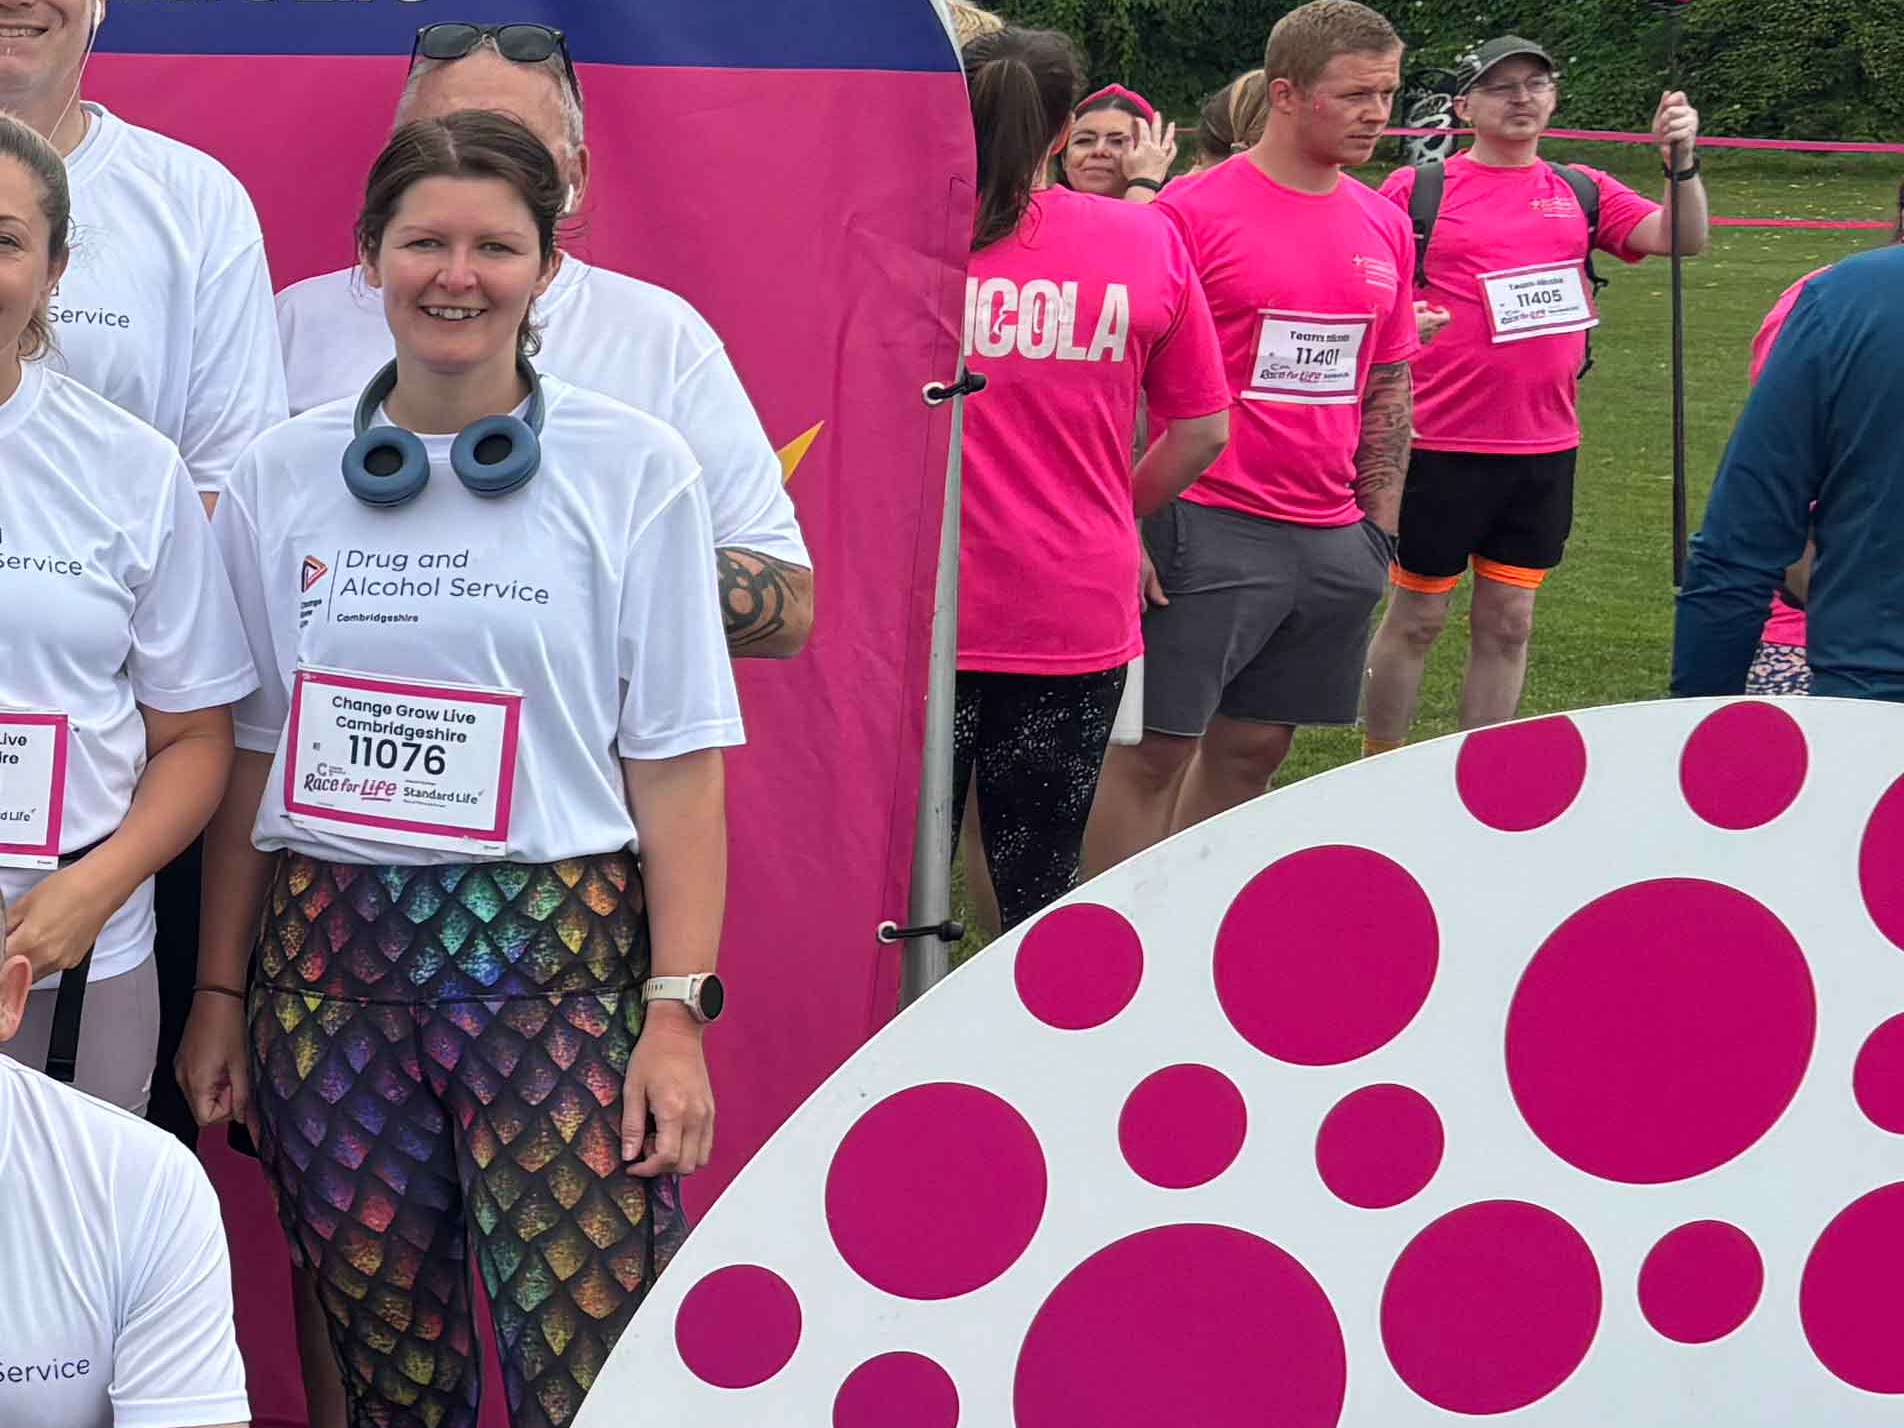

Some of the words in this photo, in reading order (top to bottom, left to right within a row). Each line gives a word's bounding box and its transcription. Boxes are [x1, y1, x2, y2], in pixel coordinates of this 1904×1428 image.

[1517, 289, 1562, 308] 11405
[47, 305, 130, 328] Service
[964, 276, 1130, 363] ICOLA
[346, 550, 409, 571] Drug
[419, 549, 470, 569] and
[340, 577, 440, 597] Alcohol
[449, 578, 550, 605] Service
[337, 612, 419, 623] Cambridgeshire
[332, 695, 392, 717] Change
[396, 703, 439, 721] Grow
[443, 707, 476, 724] Live
[336, 715, 467, 744] Cambridgeshire
[348, 734, 446, 775] 11076
[304, 773, 339, 793] Race
[340, 777, 360, 793] for
[360, 779, 397, 798] Life
[403, 785, 455, 802] Standard
[456, 790, 478, 805] Life
